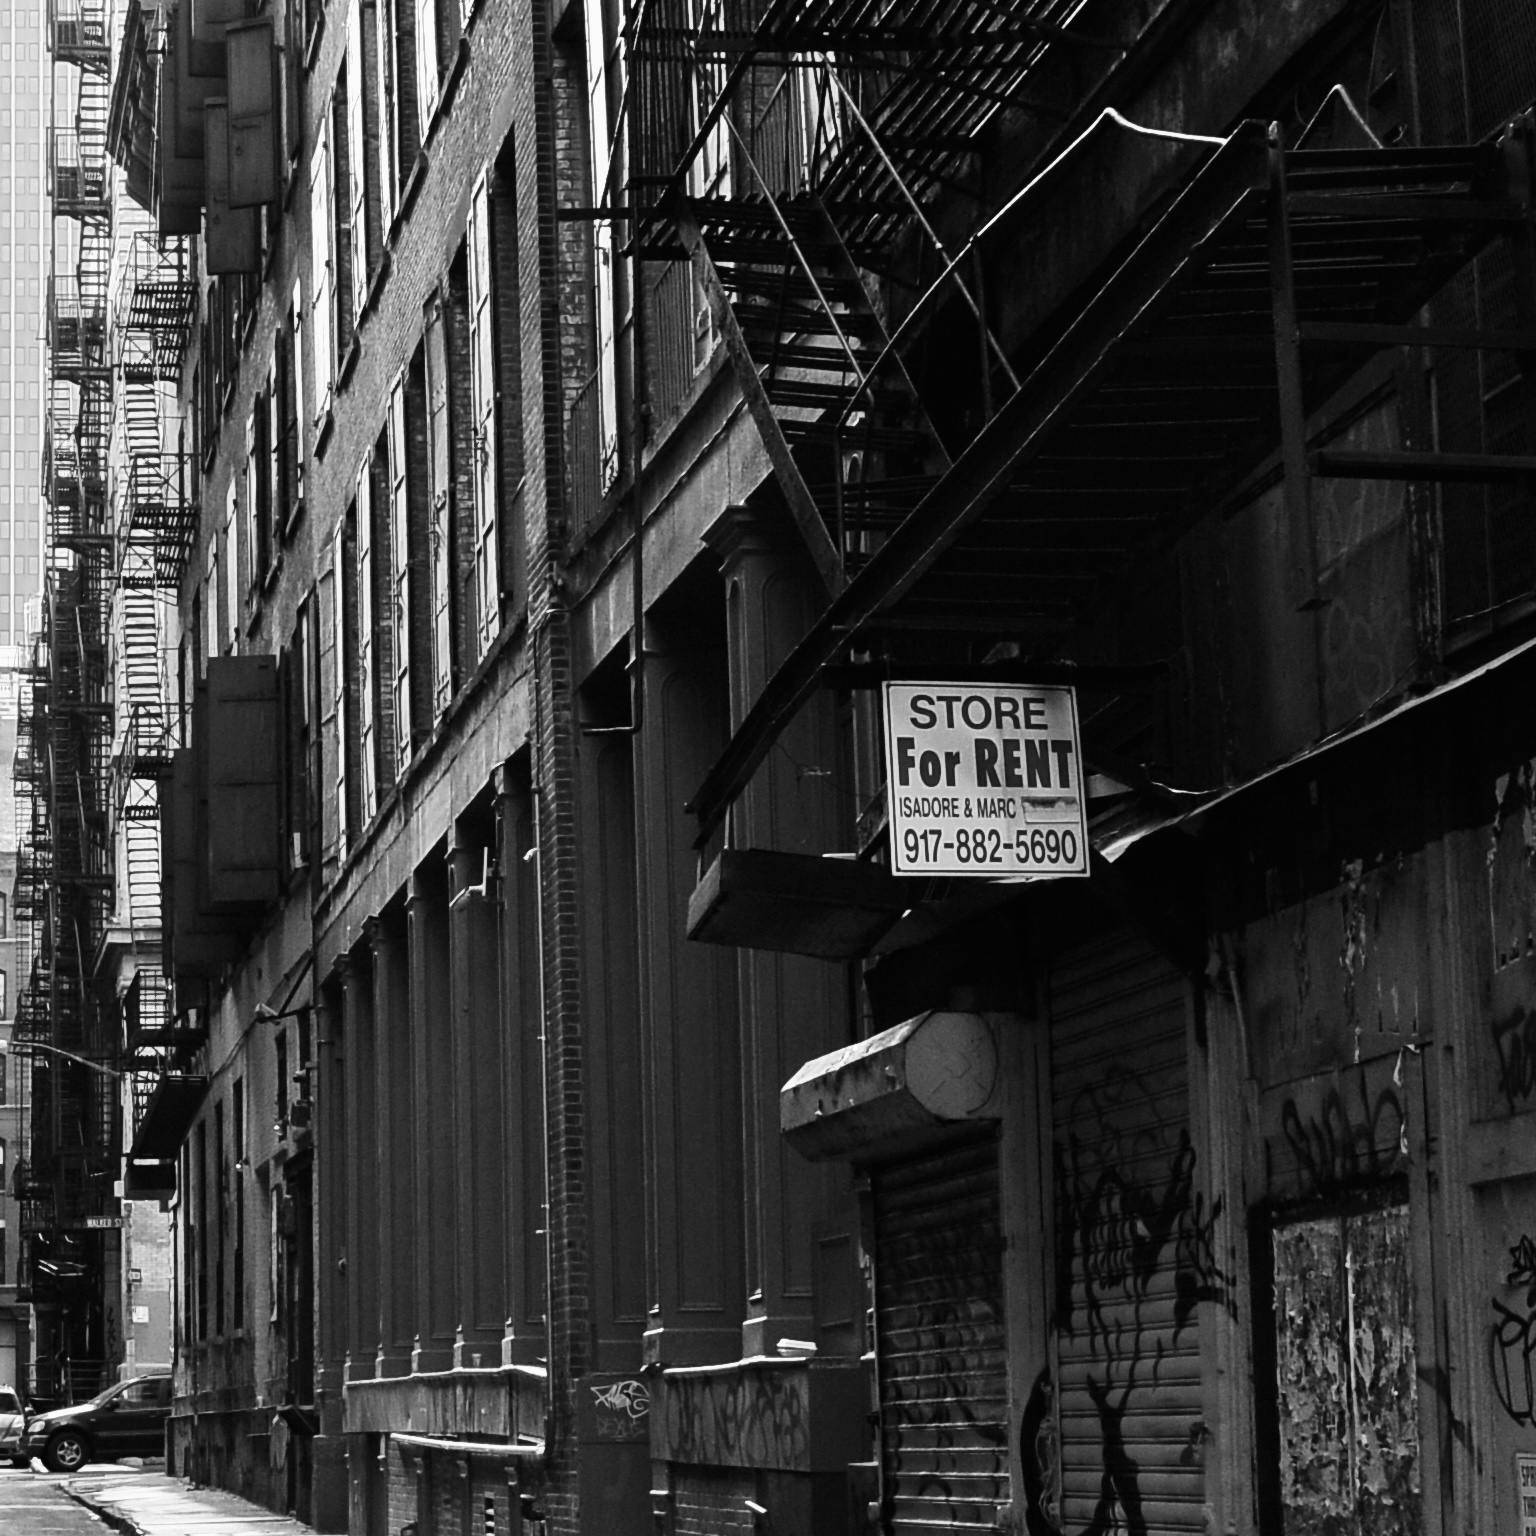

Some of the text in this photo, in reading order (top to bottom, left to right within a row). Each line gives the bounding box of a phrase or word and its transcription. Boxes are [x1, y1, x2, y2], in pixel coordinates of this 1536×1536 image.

[909, 694, 1048, 730] STORE
[896, 736, 1073, 788] For RENT
[899, 796, 1017, 819] ISADORE & MARC
[904, 828, 1077, 864] 917-882-5690
[86, 1218, 112, 1228] WALKER
